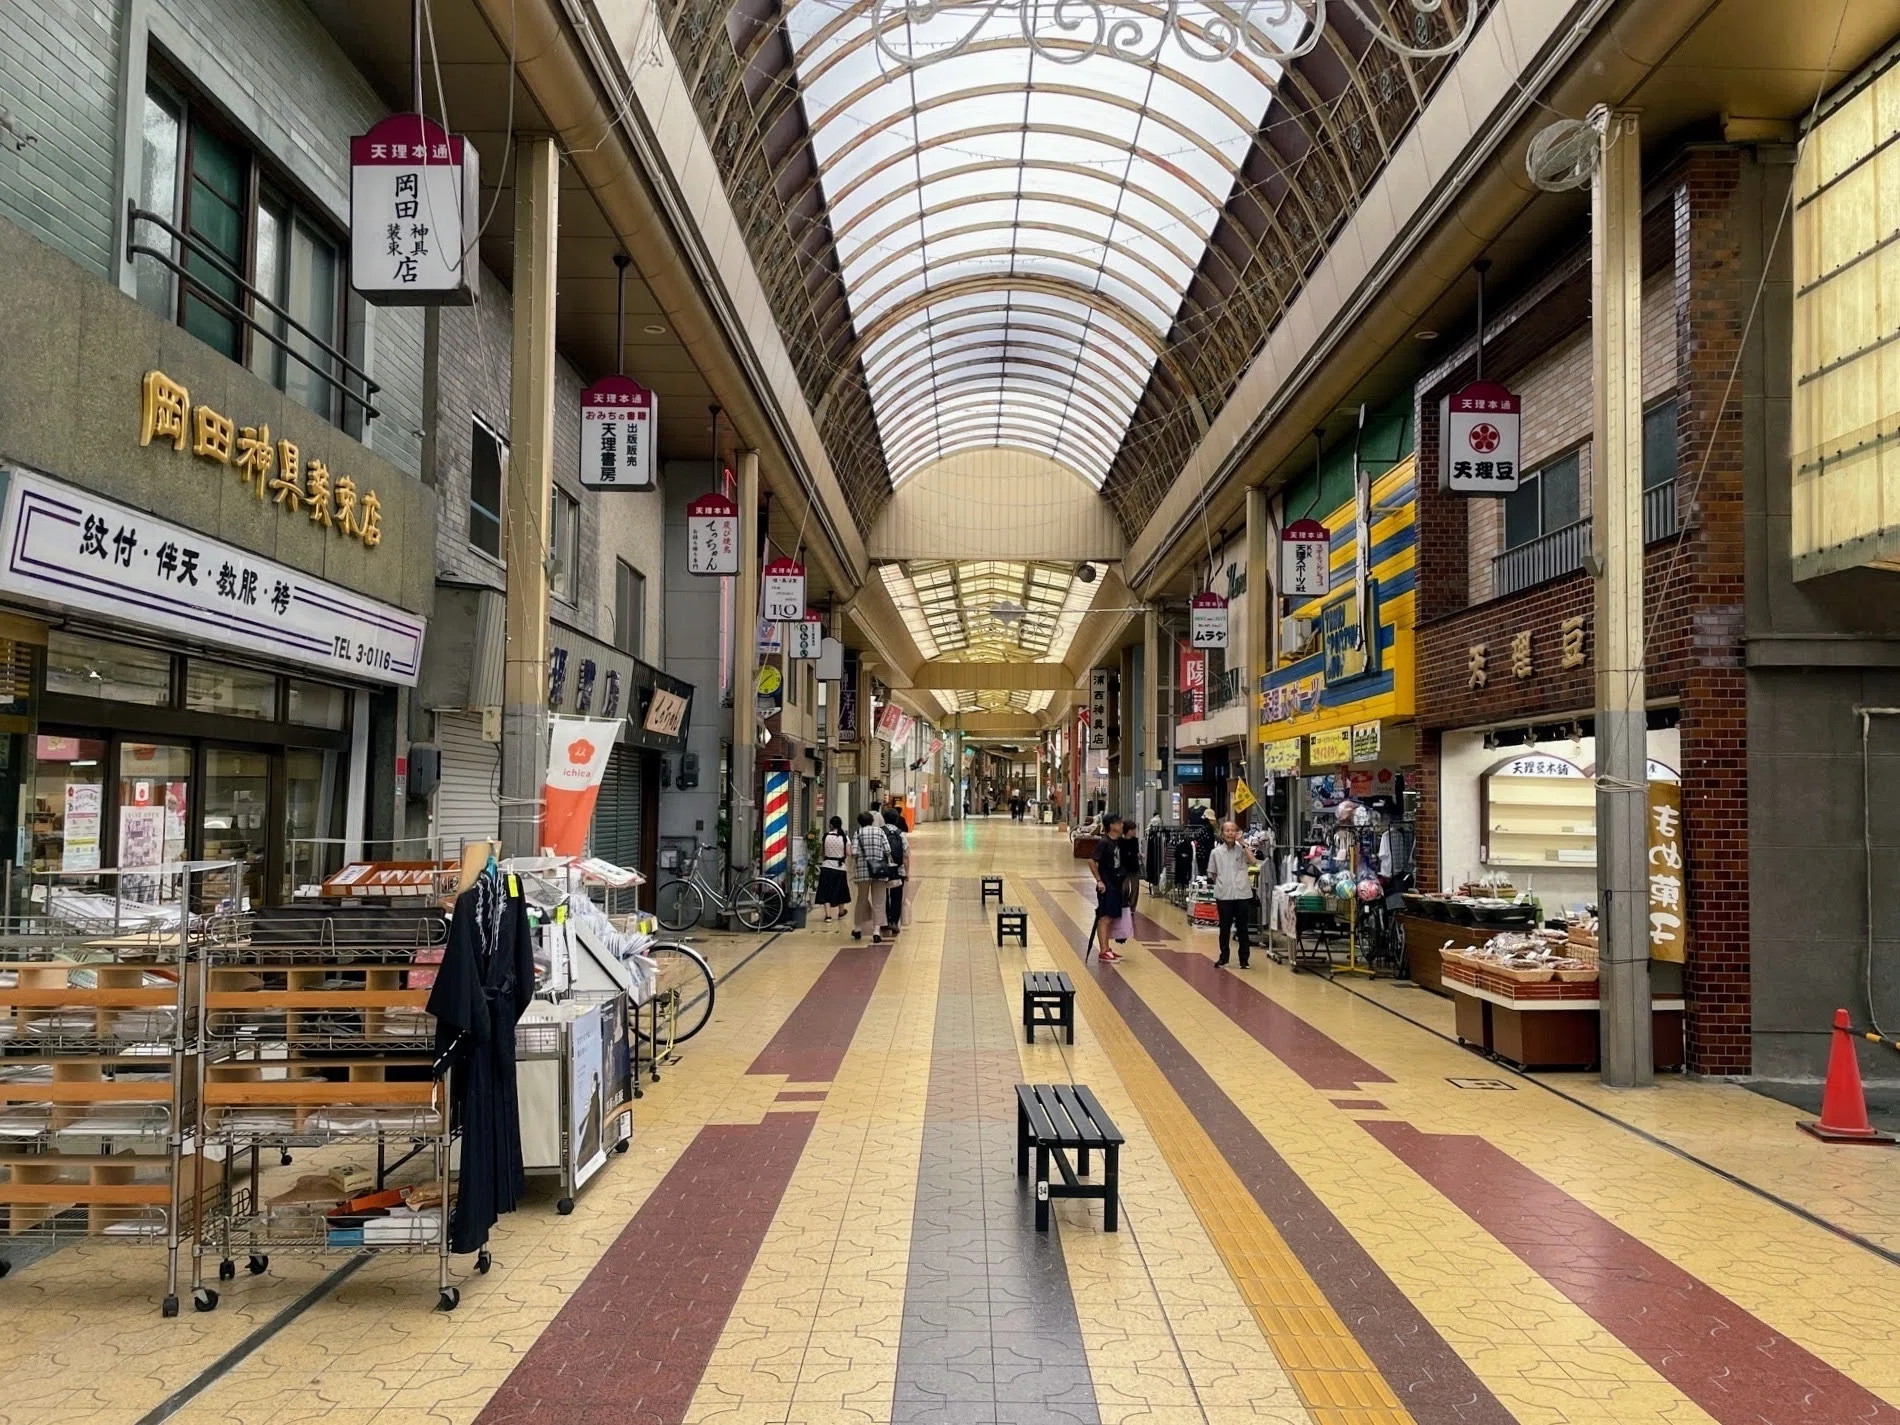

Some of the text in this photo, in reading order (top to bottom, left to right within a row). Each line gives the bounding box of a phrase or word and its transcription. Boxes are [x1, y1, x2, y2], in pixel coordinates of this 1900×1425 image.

[371, 143, 450, 159] 天理本通
[394, 173, 418, 219] 岡田
[410, 223, 429, 256] 神具
[393, 257, 418, 283] 店
[593, 393, 642, 403] 天理本通
[1461, 399, 1511, 410] 天理本通
[586, 411, 647, 421] おみちの書籍
[600, 422, 617, 482] 天理書房
[626, 423, 637, 467] 出版販売
[1453, 460, 1515, 481] 天理豆
[695, 507, 731, 515] 天理本通
[705, 520, 719, 571] てっちゃん
[1290, 531, 1324, 539] 天理本通
[1296, 544, 1307, 592] 天理スポーツ社
[1195, 631, 1226, 642] ムラタ
[333, 635, 351, 661] TEL
[1092, 675, 1105, 745] 浦西神具店
[563, 770, 591, 778] ichica
[1512, 761, 1569, 776] 天理豆本舗
[1648, 804, 1683, 946] まめ菓子
[1038, 1186, 1048, 1196] 34
